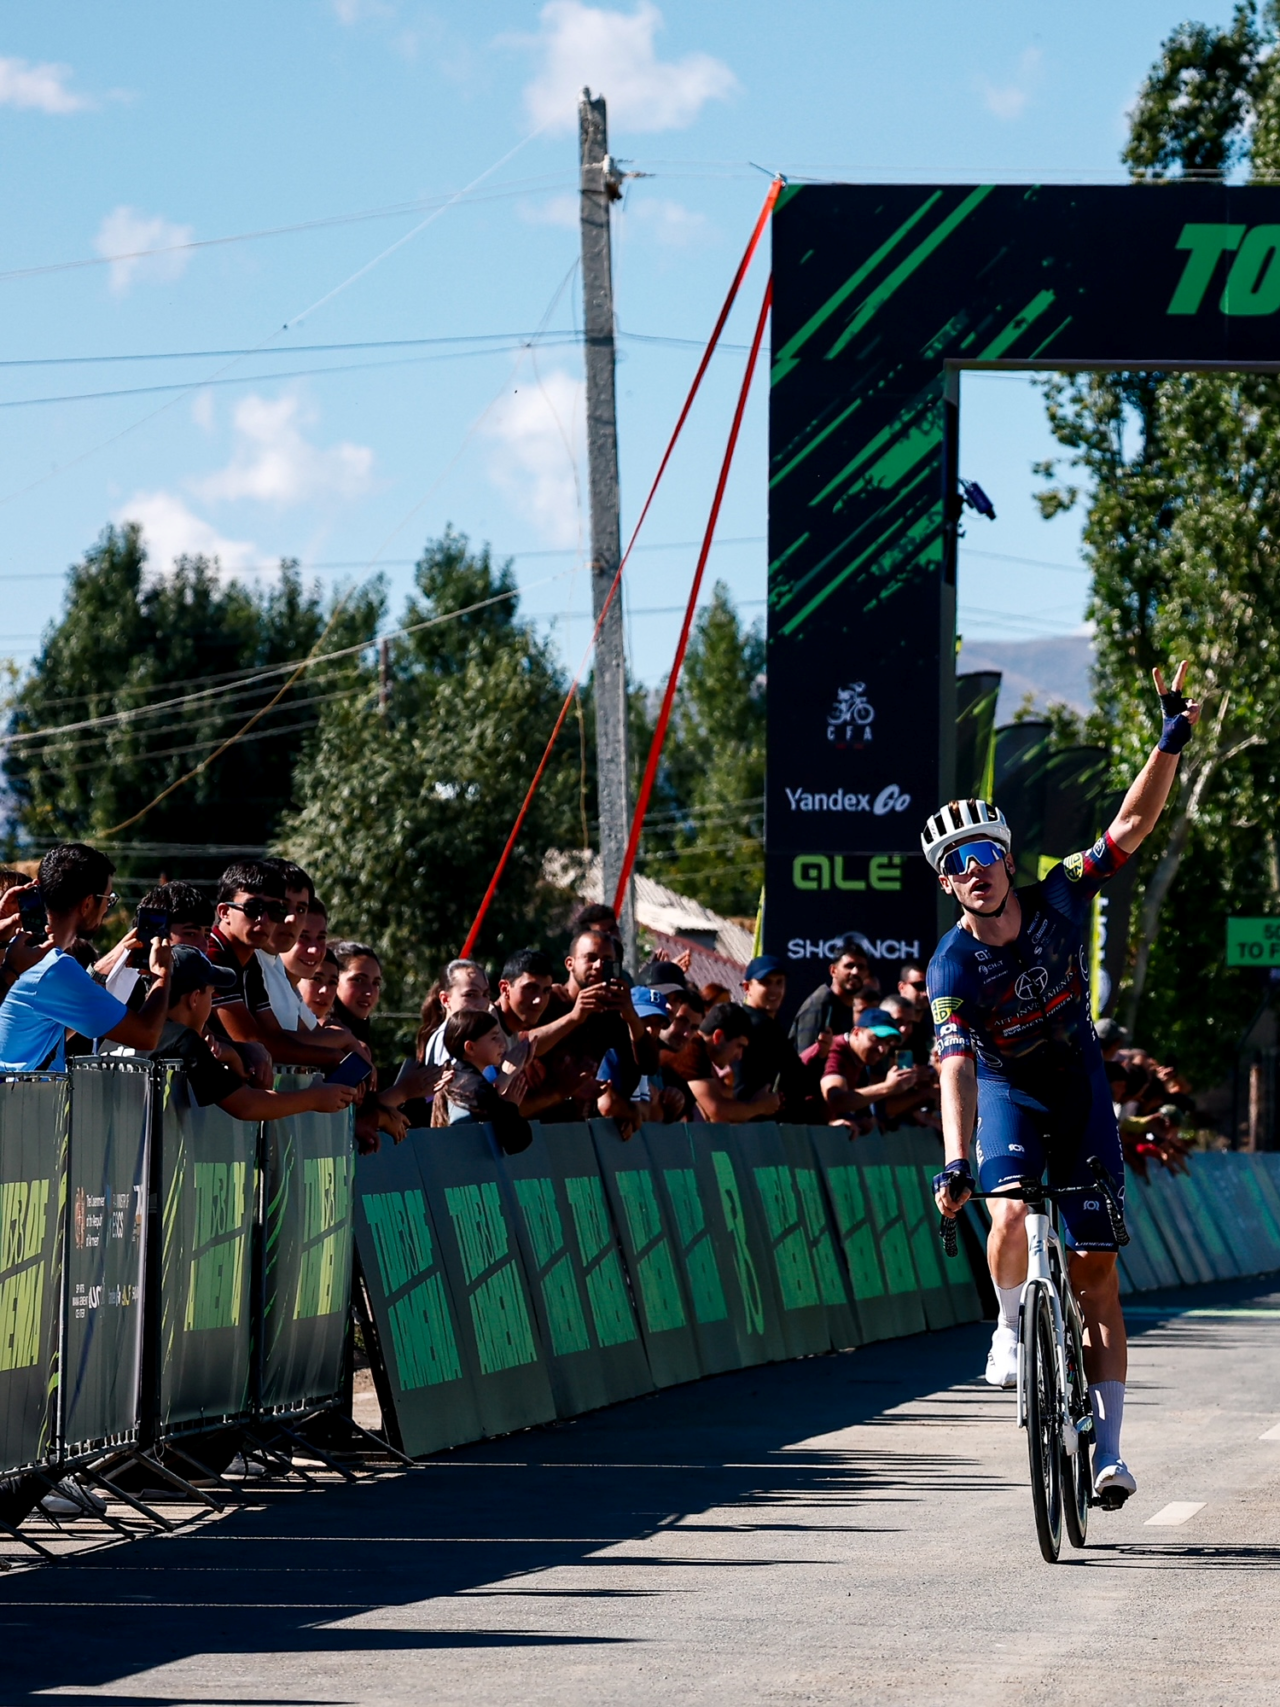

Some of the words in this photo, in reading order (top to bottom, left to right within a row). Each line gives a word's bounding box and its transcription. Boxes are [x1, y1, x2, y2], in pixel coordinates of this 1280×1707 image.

[785, 788, 870, 811] Yandex
[873, 784, 911, 816] Go
[1238, 942, 1264, 959] TO
